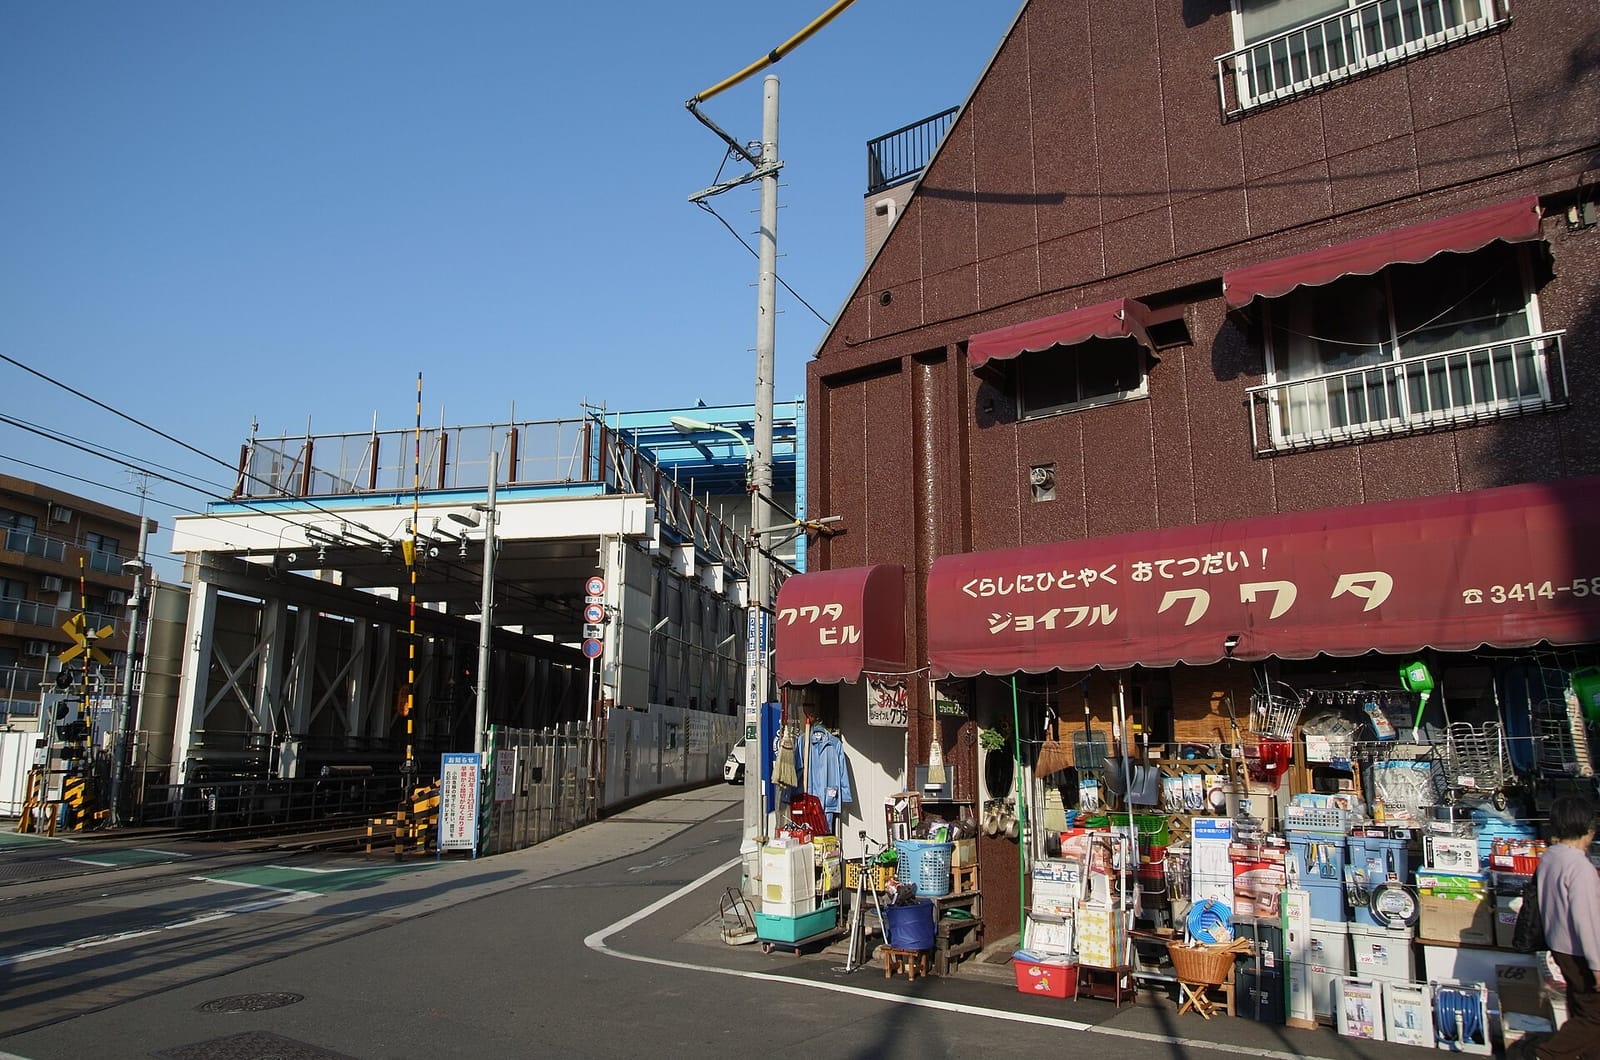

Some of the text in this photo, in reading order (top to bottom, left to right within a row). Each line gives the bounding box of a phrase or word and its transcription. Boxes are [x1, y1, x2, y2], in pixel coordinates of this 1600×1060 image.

[962, 563, 1118, 598] くらしにひとやく
[777, 603, 843, 626] クワタ
[987, 571, 1394, 635] ジョイフル クワタ
[819, 625, 861, 645] ビル
